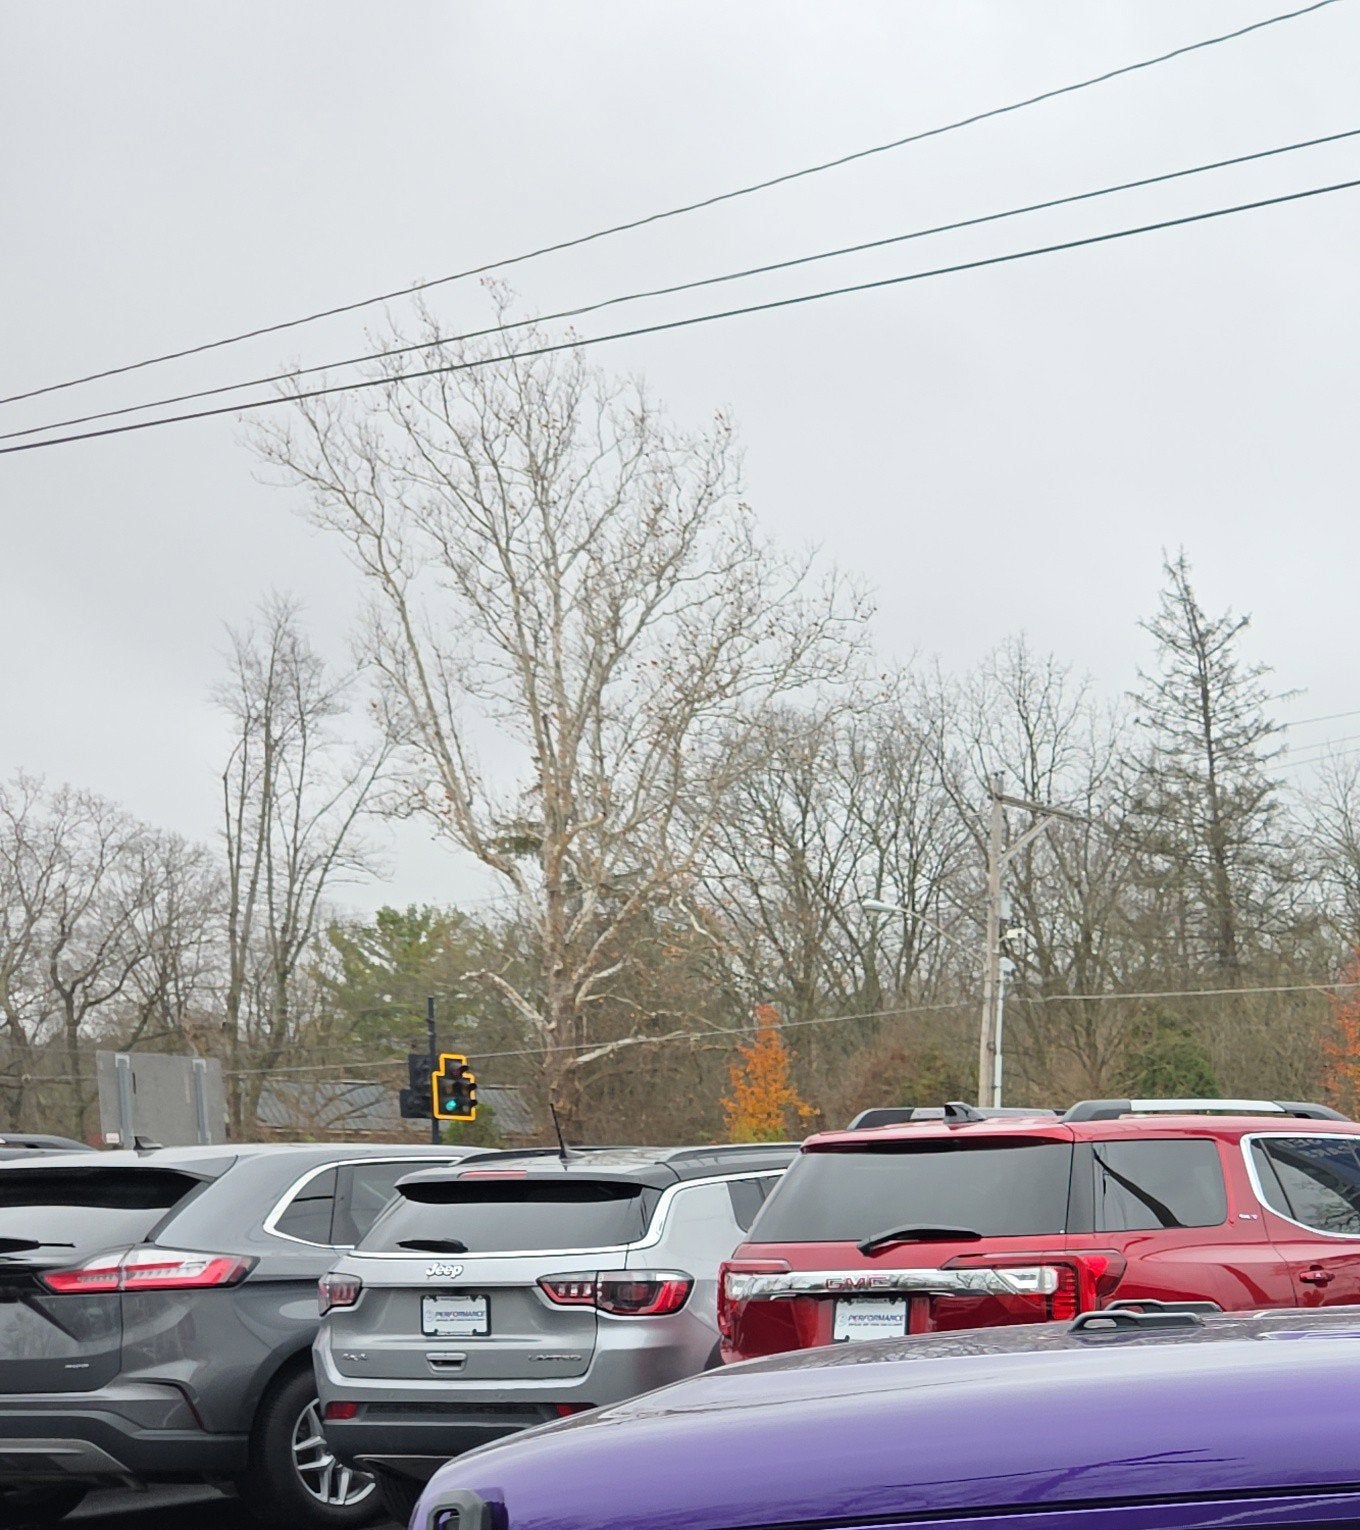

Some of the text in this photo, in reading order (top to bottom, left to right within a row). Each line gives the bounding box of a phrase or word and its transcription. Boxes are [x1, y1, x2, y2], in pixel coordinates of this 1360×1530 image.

[425, 1262, 464, 1279] Jeep
[825, 1275, 890, 1291] GMC
[434, 1310, 487, 1319] PERFORMANCE
[848, 1314, 904, 1323] PERFORMANCE
